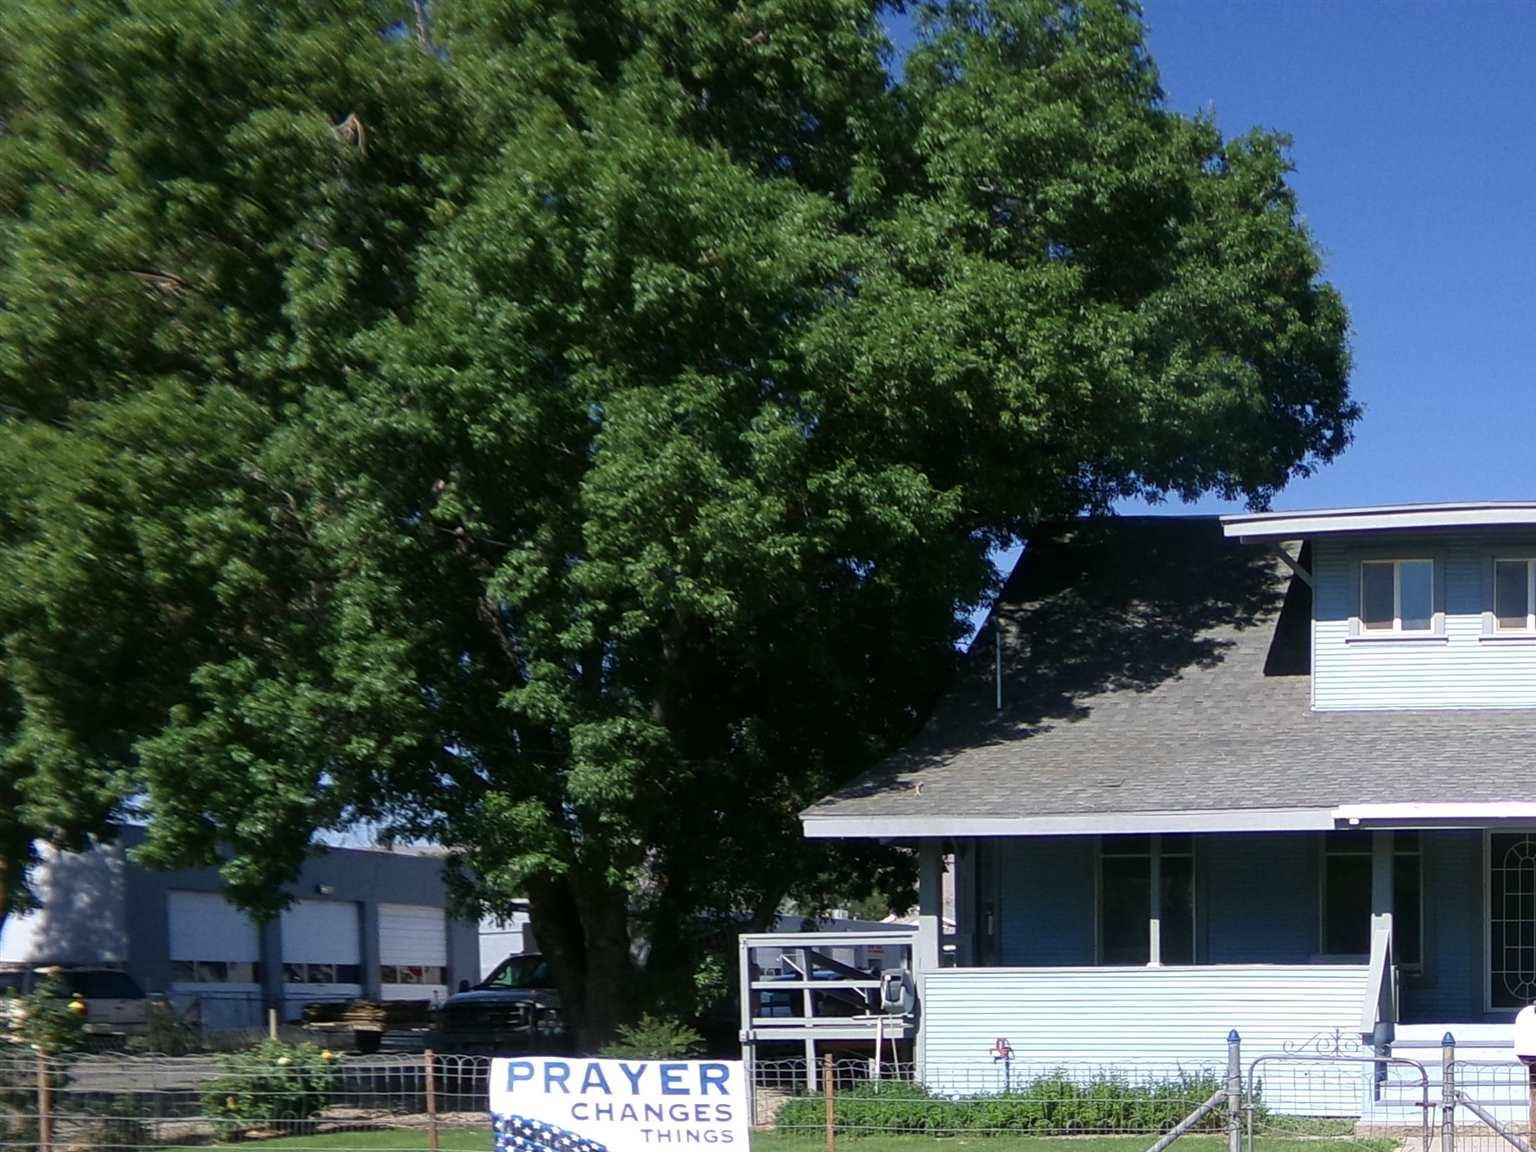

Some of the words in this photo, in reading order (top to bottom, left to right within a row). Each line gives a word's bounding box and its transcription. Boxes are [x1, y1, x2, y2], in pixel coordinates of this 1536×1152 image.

[506, 1061, 730, 1095] PRAYER
[571, 1102, 732, 1122] CHANGES
[640, 1129, 734, 1143] THINGS
